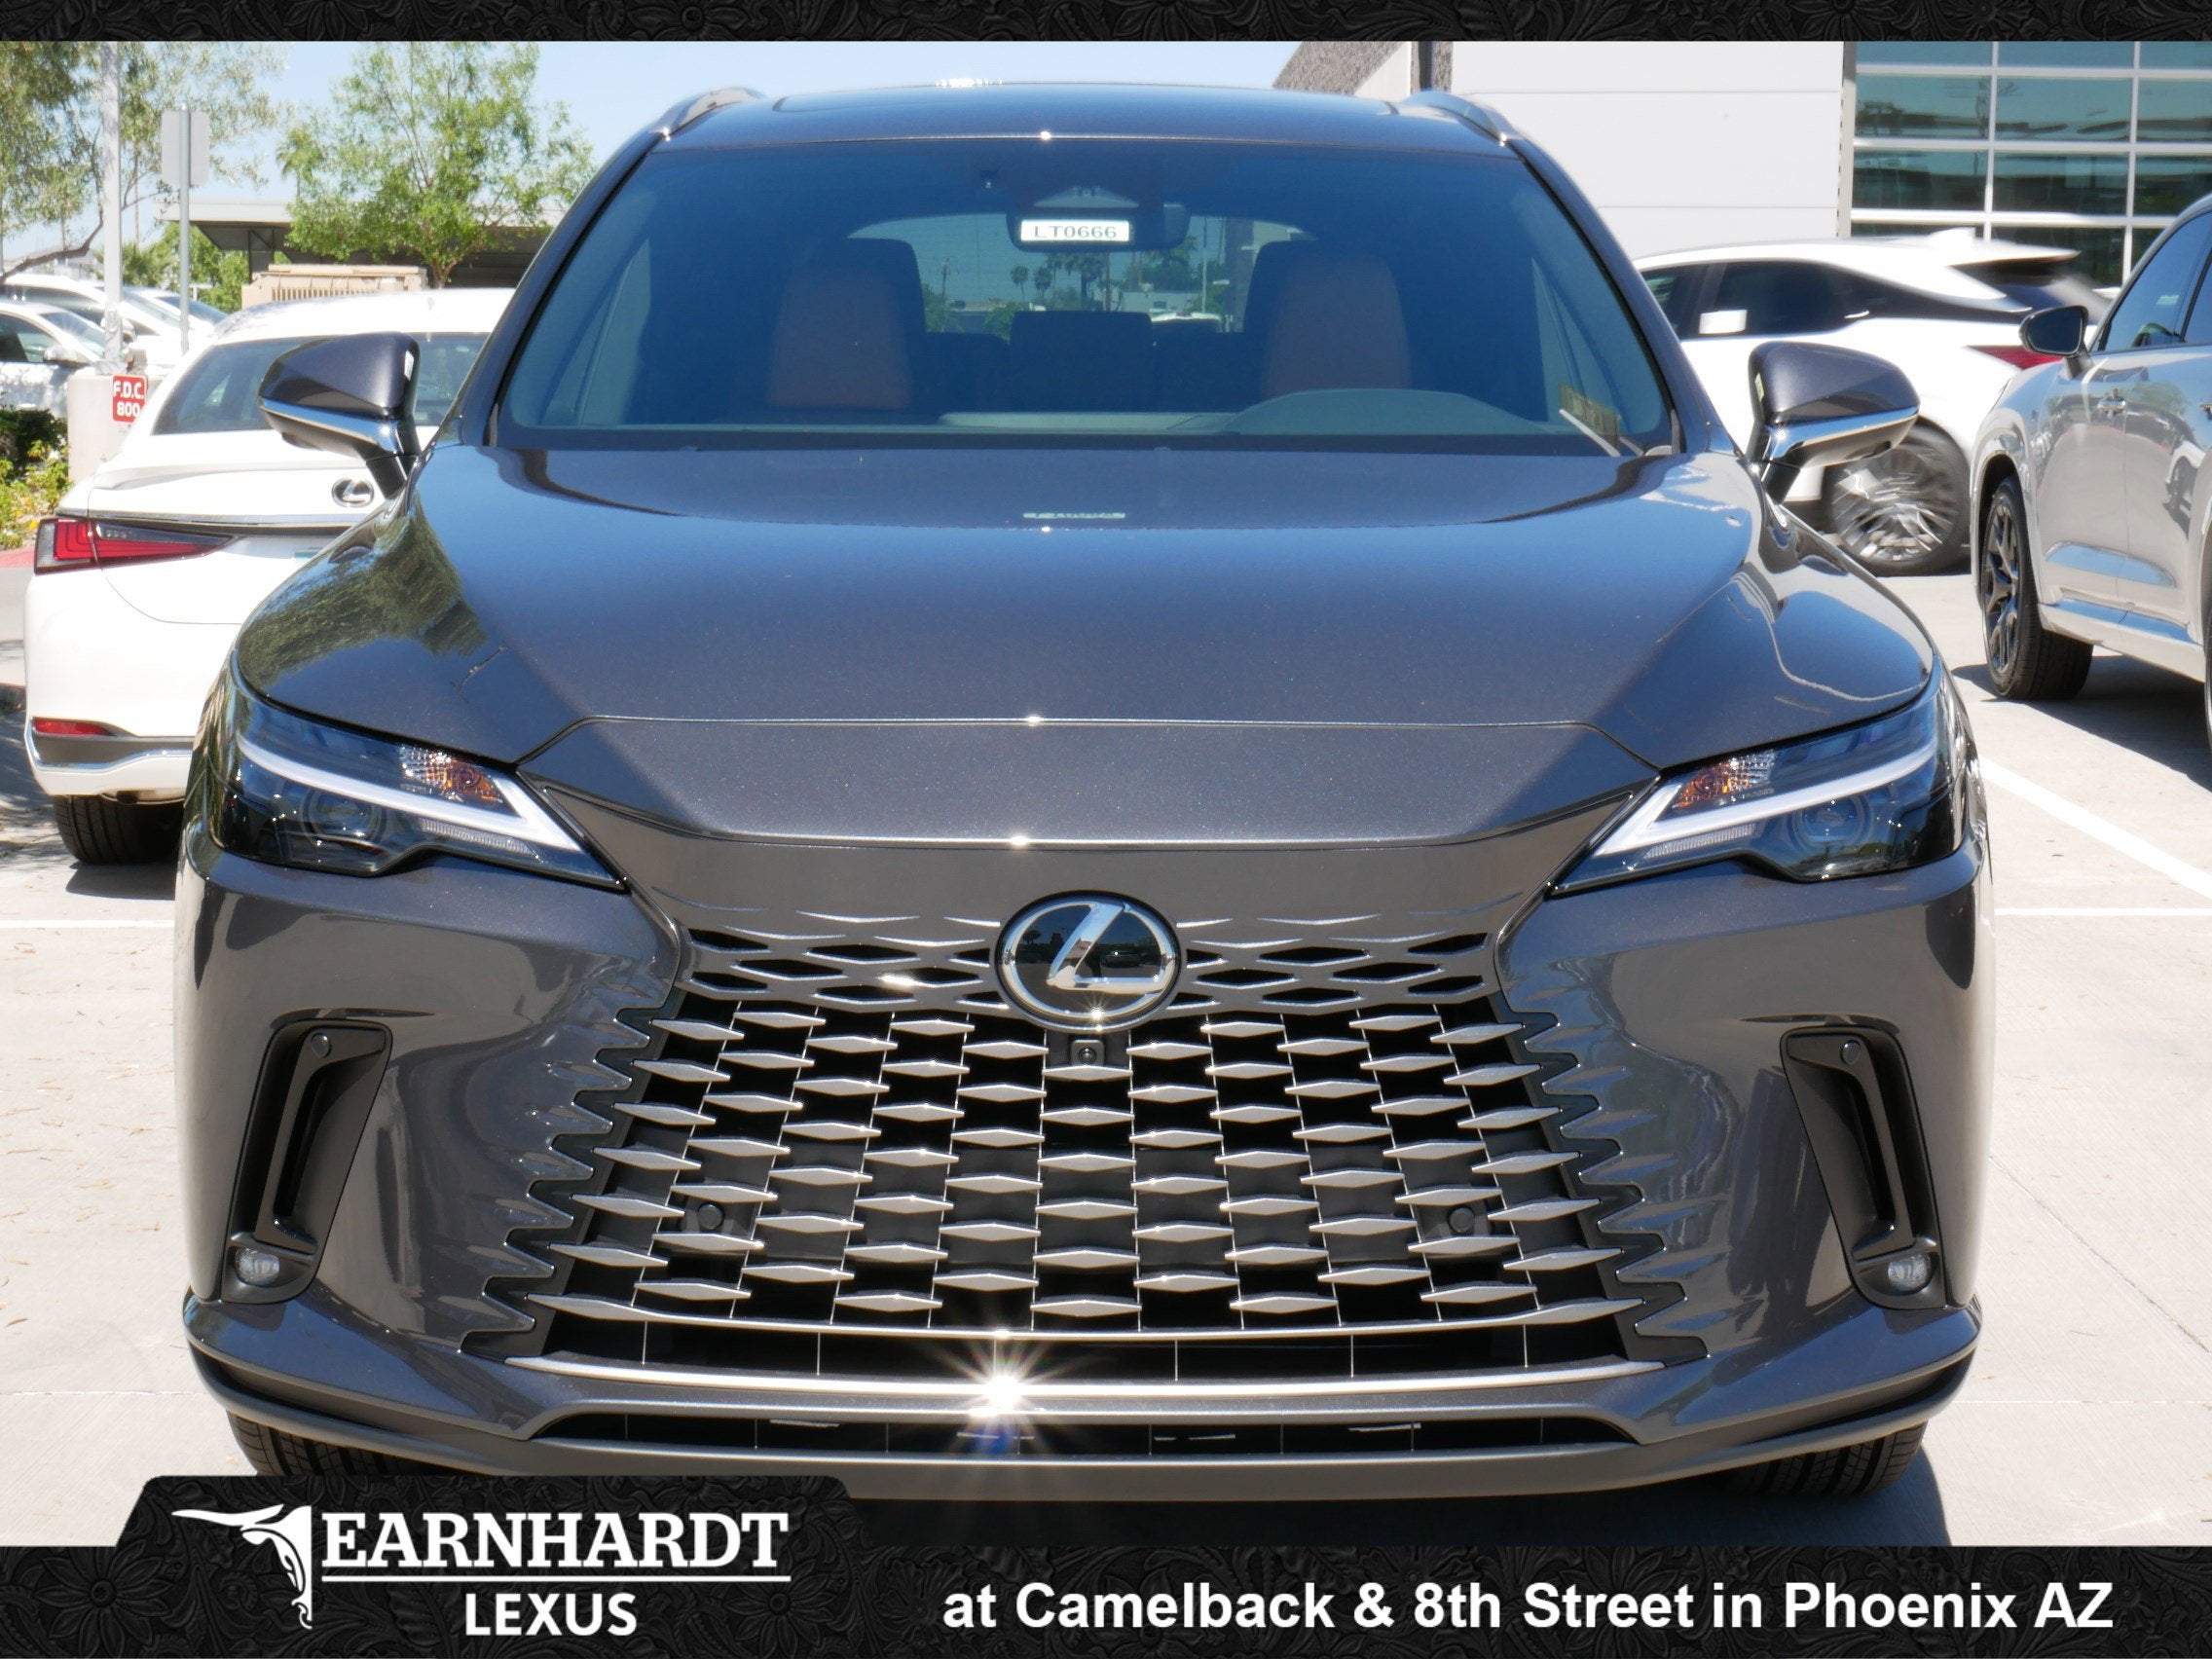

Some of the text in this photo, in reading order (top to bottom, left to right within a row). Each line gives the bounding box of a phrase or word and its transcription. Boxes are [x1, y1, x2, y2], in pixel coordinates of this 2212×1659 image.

[1033, 224, 1118, 240] LT0666
[113, 380, 145, 400] F.D.C.
[117, 401, 141, 418] 800
